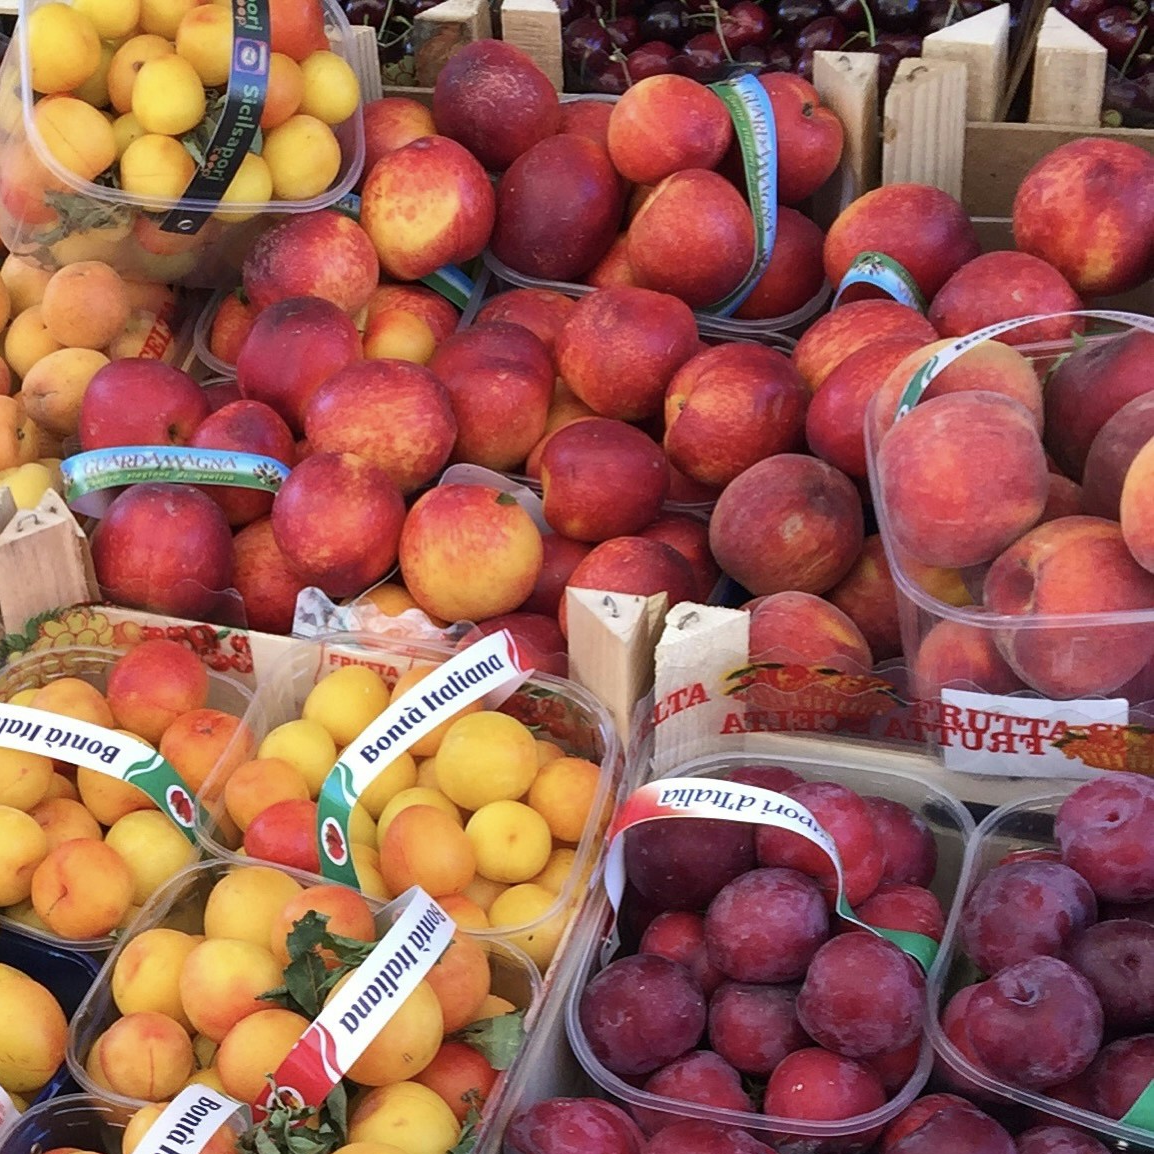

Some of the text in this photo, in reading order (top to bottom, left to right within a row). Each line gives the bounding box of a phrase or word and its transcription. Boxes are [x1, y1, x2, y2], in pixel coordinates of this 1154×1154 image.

[245, 0, 263, 32] ori
[207, 83, 261, 182] Sicilsapori
[82, 450, 238, 475] GUARDAMAGNA
[359, 706, 427, 765] Bontà
[421, 653, 505, 712] Italiana
[911, 699, 1071, 742] FRUTTA
[45, 726, 121, 765] Bontà
[660, 787, 757, 812] d'Italia
[338, 902, 447, 1035] Bontà Italiana
[165, 1095, 222, 1146] Bontà
